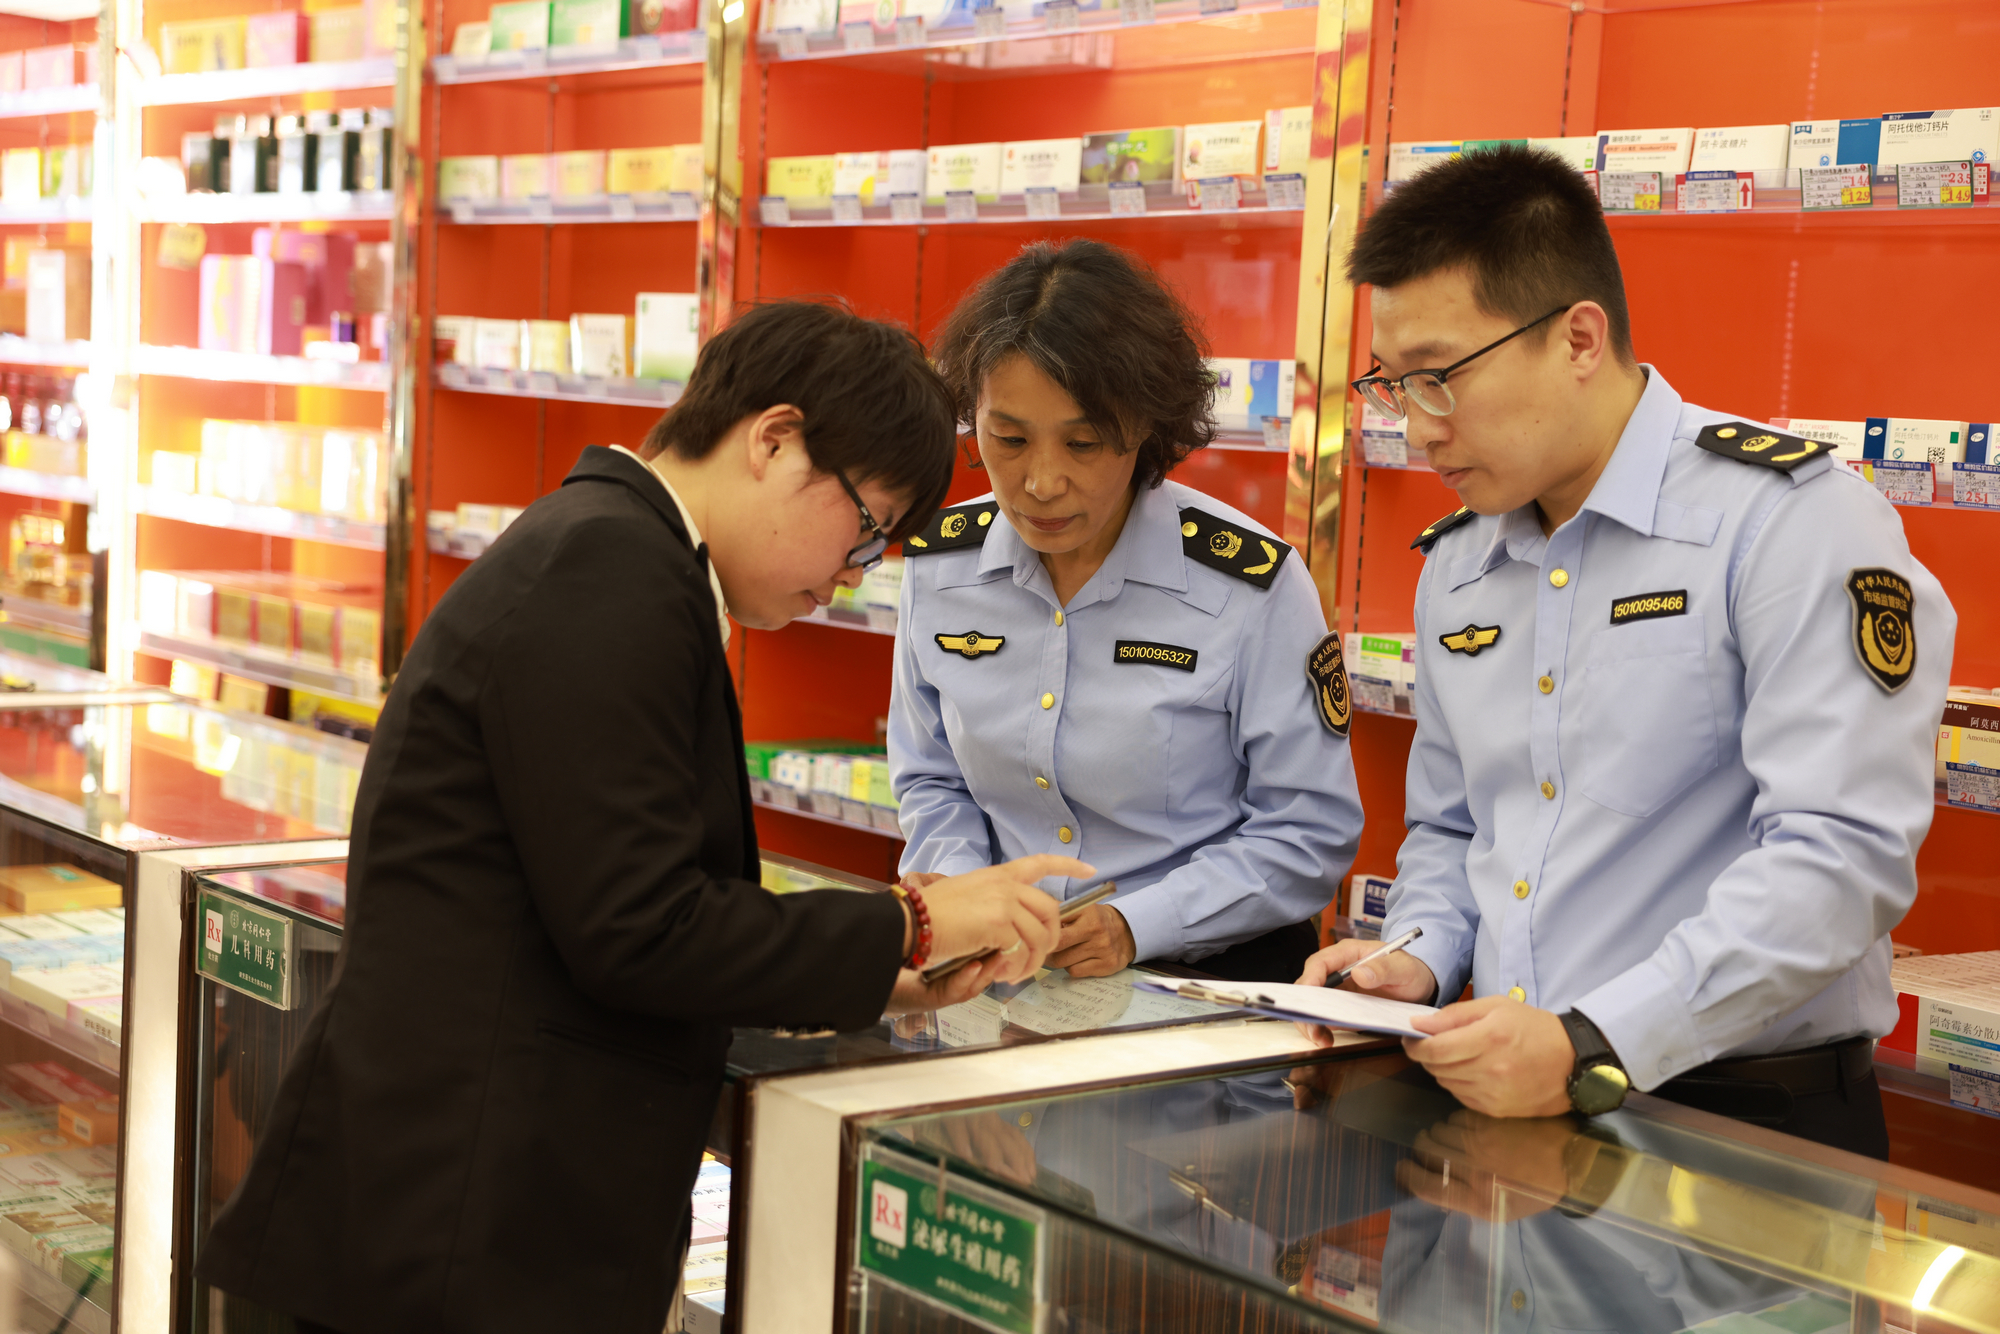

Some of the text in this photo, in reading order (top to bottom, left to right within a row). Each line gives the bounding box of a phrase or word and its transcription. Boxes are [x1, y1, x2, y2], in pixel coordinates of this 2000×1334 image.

[1887, 121, 1949, 134] 阿托伐他汀钙片
[1699, 138, 1748, 149] 阿卡波糖片
[1850, 175, 1869, 187] 14.4
[1948, 173, 1970, 184] 23.5
[1642, 182, 1656, 193] 69
[1850, 191, 1870, 202] 12.9
[1948, 189, 1970, 202] 14.9
[1894, 432, 1940, 441] 阿托伐他汀钙片
[1884, 490, 1913, 501] 42.77
[1855, 575, 1911, 602] 中华人民共和国
[1613, 596, 1684, 618] 15010095466
[1862, 591, 1908, 612] 市场监管执法
[1118, 645, 1192, 666] 15010095327
[1970, 717, 1999, 731] 阿莫西
[1960, 792, 1976, 804] 20
[208, 918, 221, 943] Rx
[241, 919, 272, 943] 北京同仁堂
[230, 934, 276, 971] 儿科用药
[876, 1192, 903, 1231] Rx
